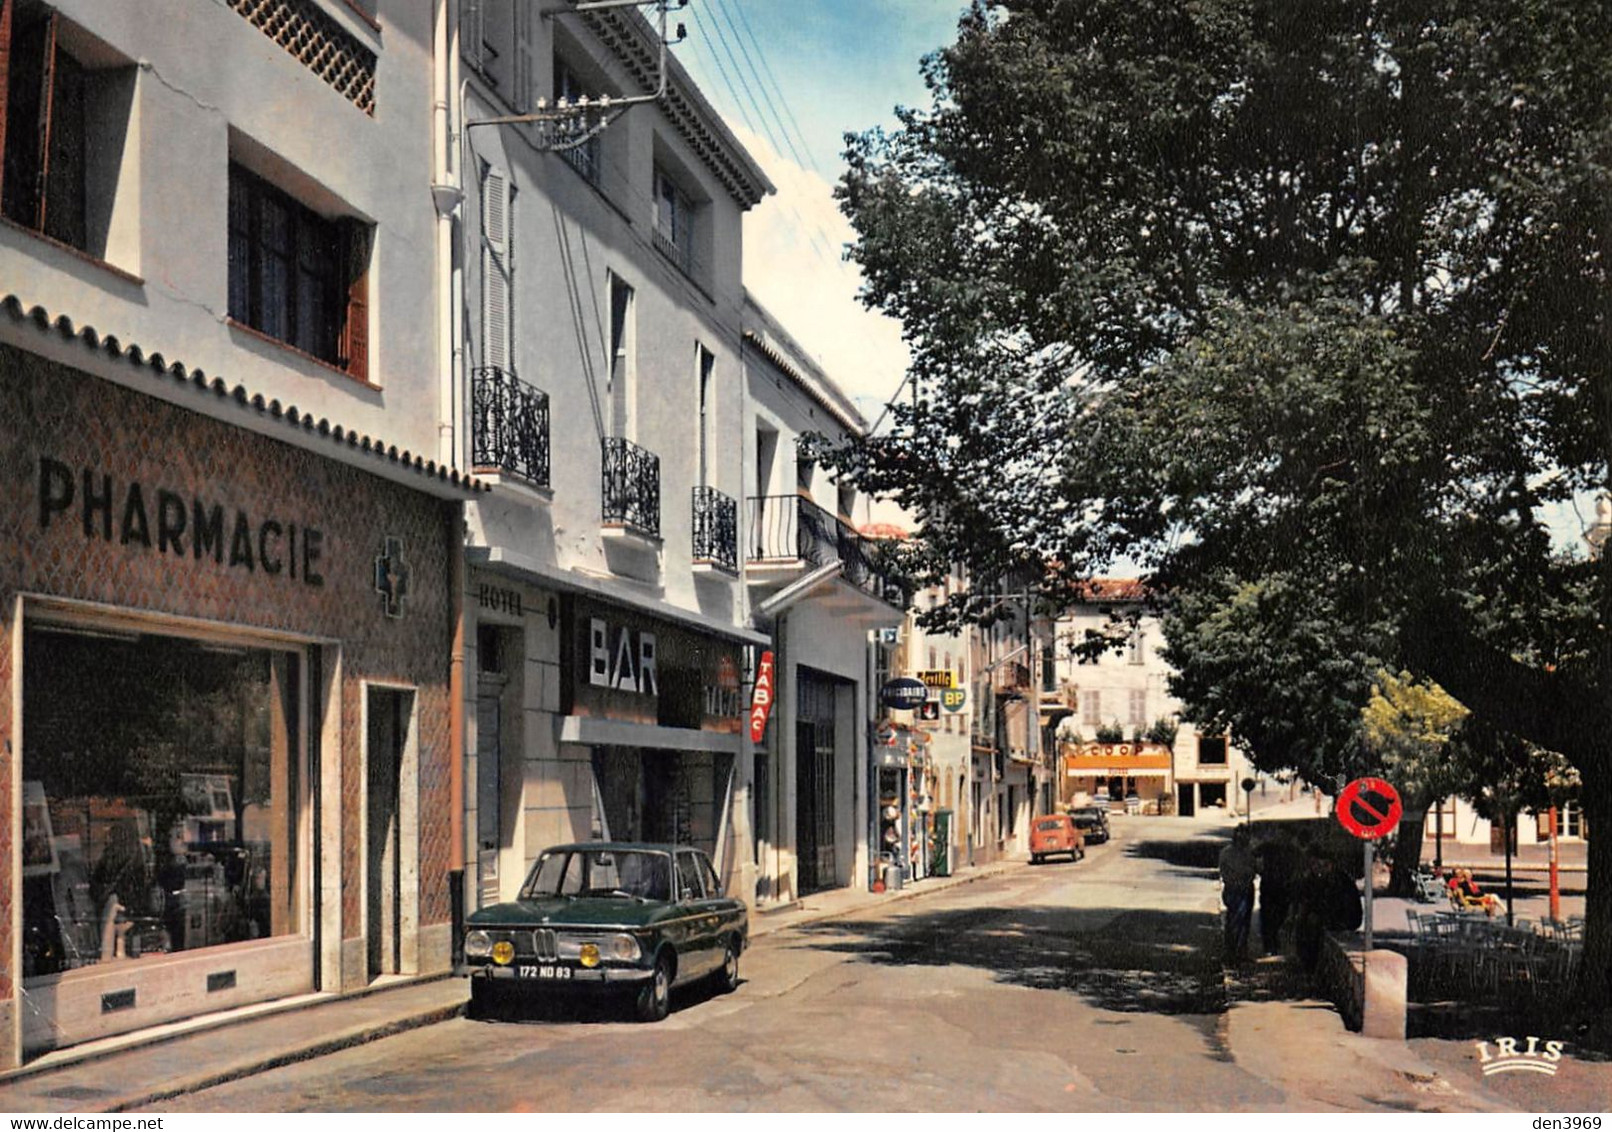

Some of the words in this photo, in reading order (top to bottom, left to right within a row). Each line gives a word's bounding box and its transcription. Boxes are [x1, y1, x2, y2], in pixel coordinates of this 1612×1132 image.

[38, 457, 324, 586] PHARMACIE
[480, 583, 524, 616] HOTEL
[590, 617, 658, 696] BAR
[752, 662, 772, 730] TABAC
[945, 692, 964, 705] BP
[520, 966, 537, 977] 172
